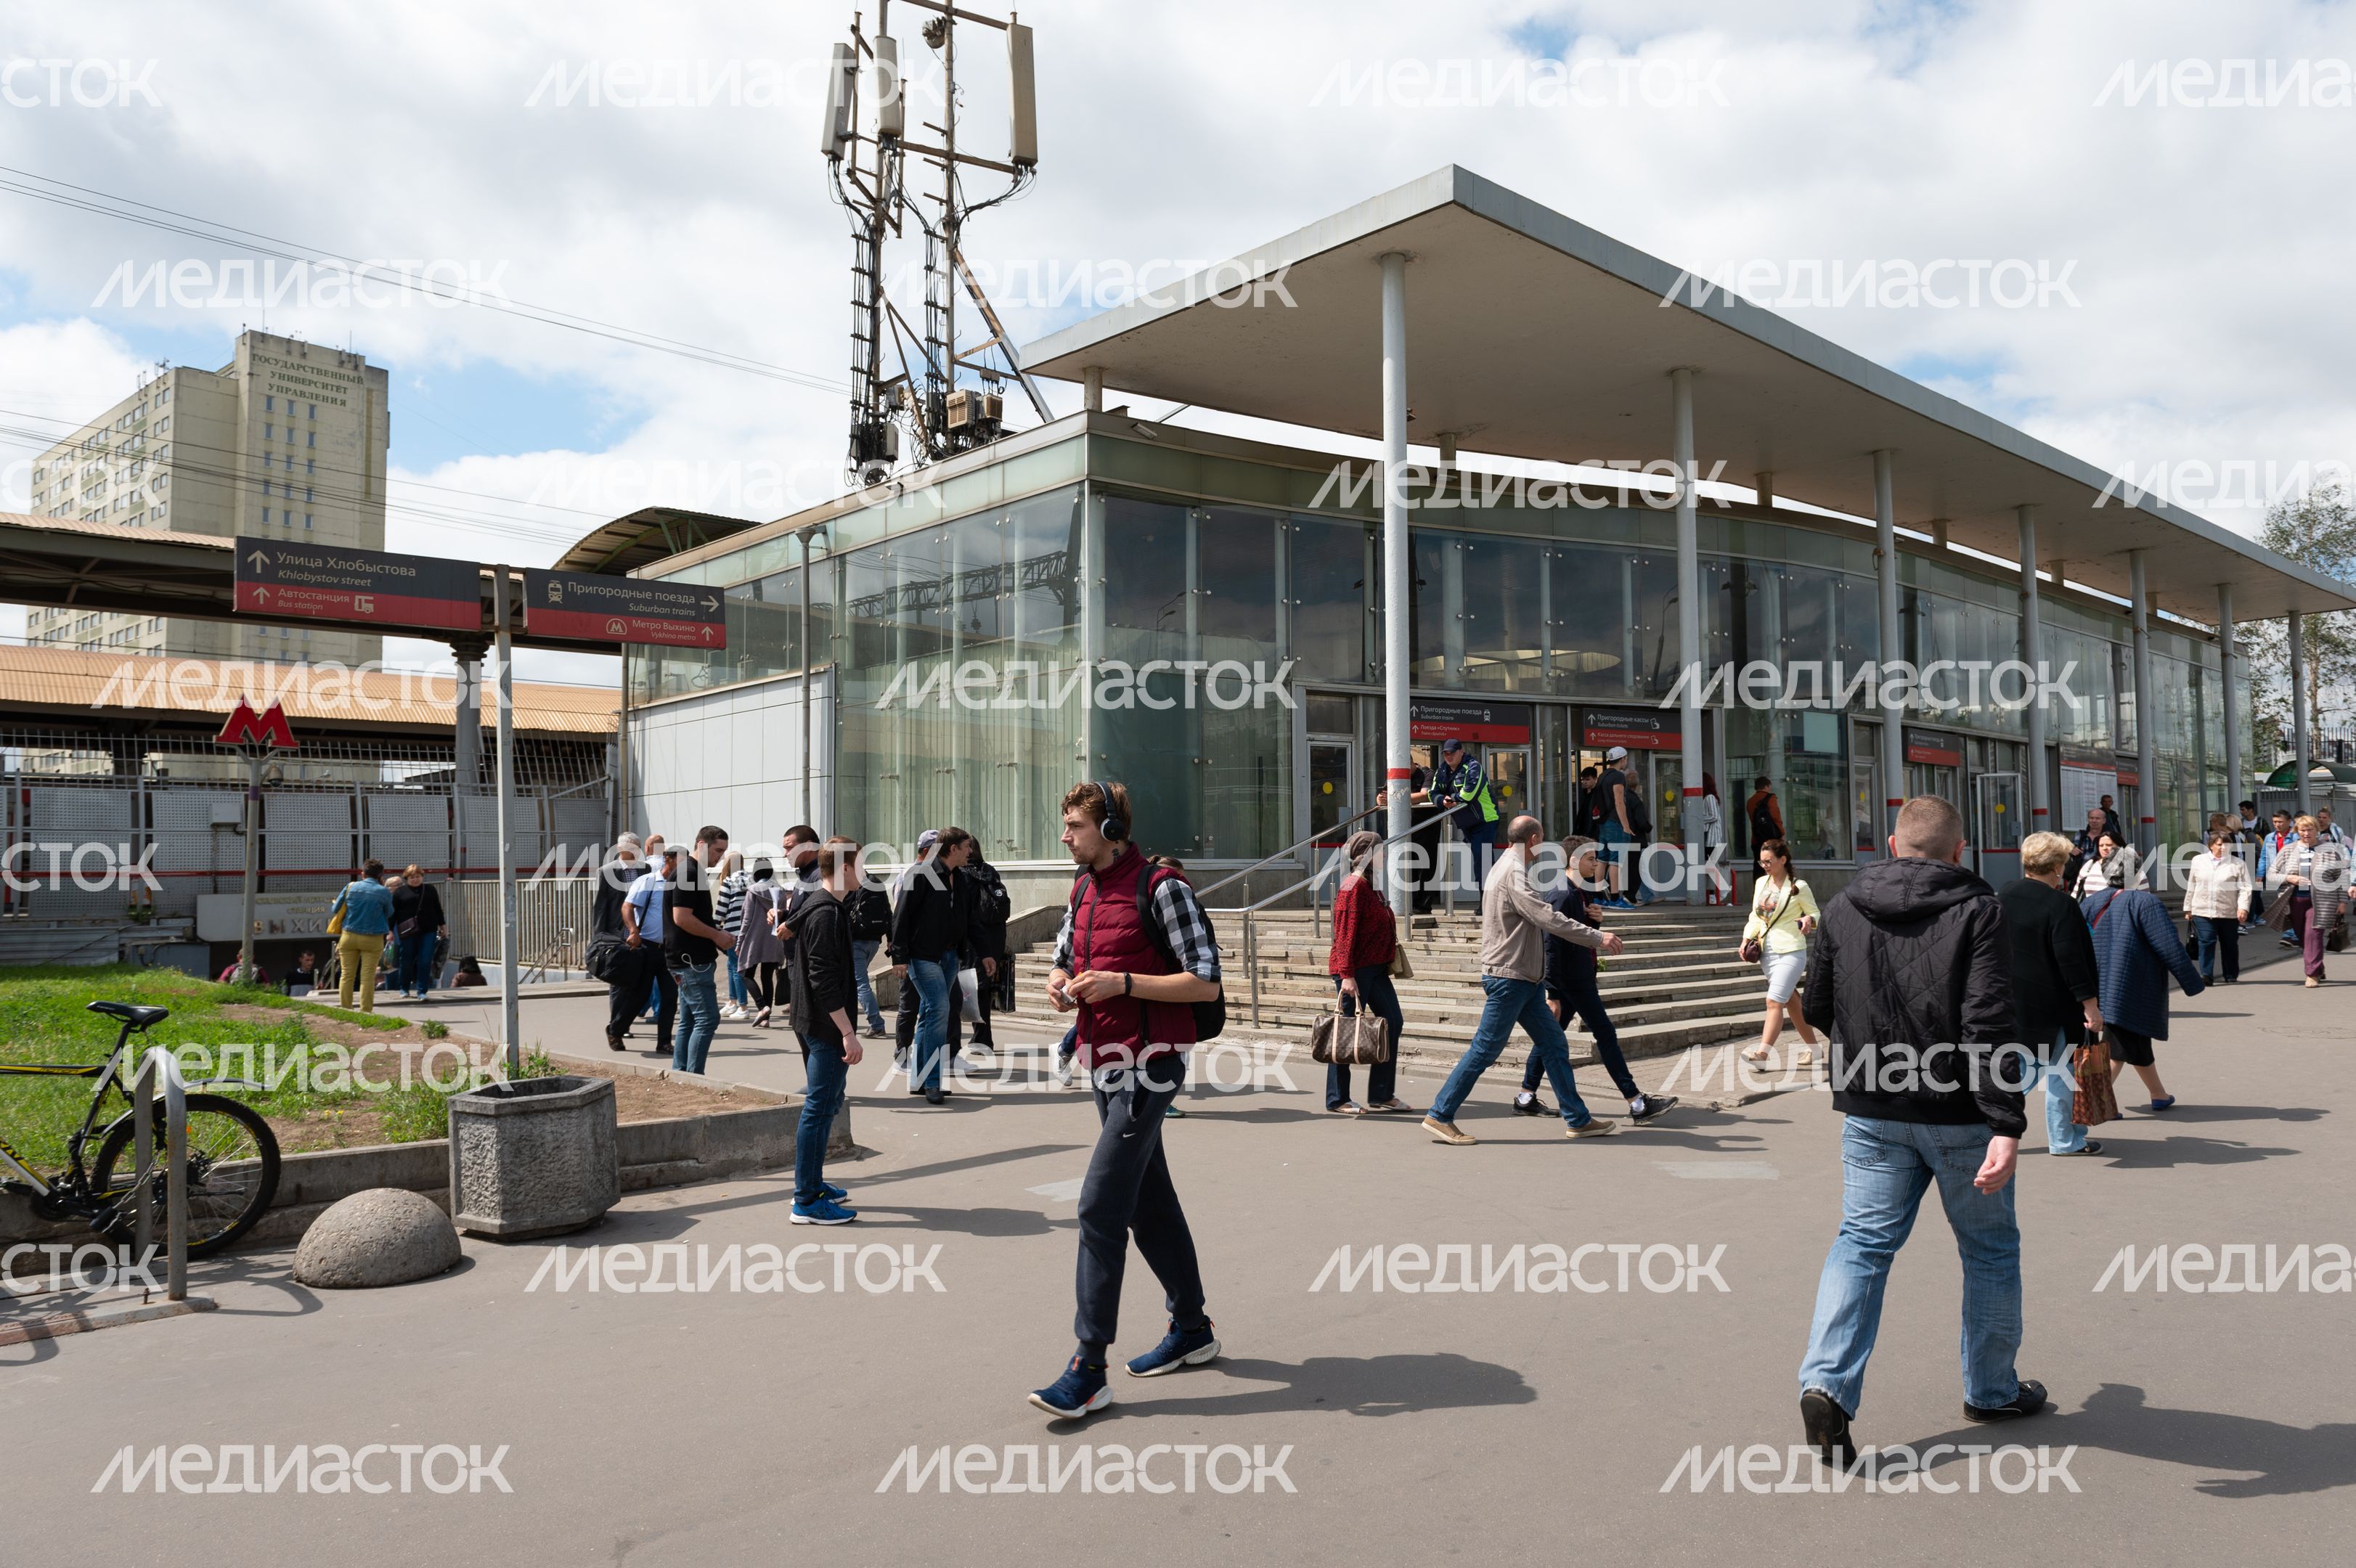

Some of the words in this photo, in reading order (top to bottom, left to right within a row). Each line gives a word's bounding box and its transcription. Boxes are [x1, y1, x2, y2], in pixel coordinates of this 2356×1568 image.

[252, 354, 364, 385] ГОСУДАРСТВЕННЫЙ
[270, 371, 348, 394] УНИВЕРСИТЕТ
[268, 383, 346, 407] УПРАВЛЕНИЯ
[277, 552, 322, 568] Улица
[327, 558, 416, 576] Хлобыстова
[278, 570, 339, 584] Khlobystov
[341, 576, 372, 587] street
[278, 588, 349, 603] Автостанция
[568, 582, 652, 600] Пригородные
[655, 592, 696, 604] поезда
[278, 600, 293, 609] Bus
[294, 601, 323, 611] station
[629, 603, 670, 615] Suburban
[672, 607, 696, 616] trains
[632, 620, 661, 630] Метро
[664, 622, 696, 632] Выхино
[651, 632, 677, 640] Vykhino
[254, 918, 331, 934] ВЫХИ
